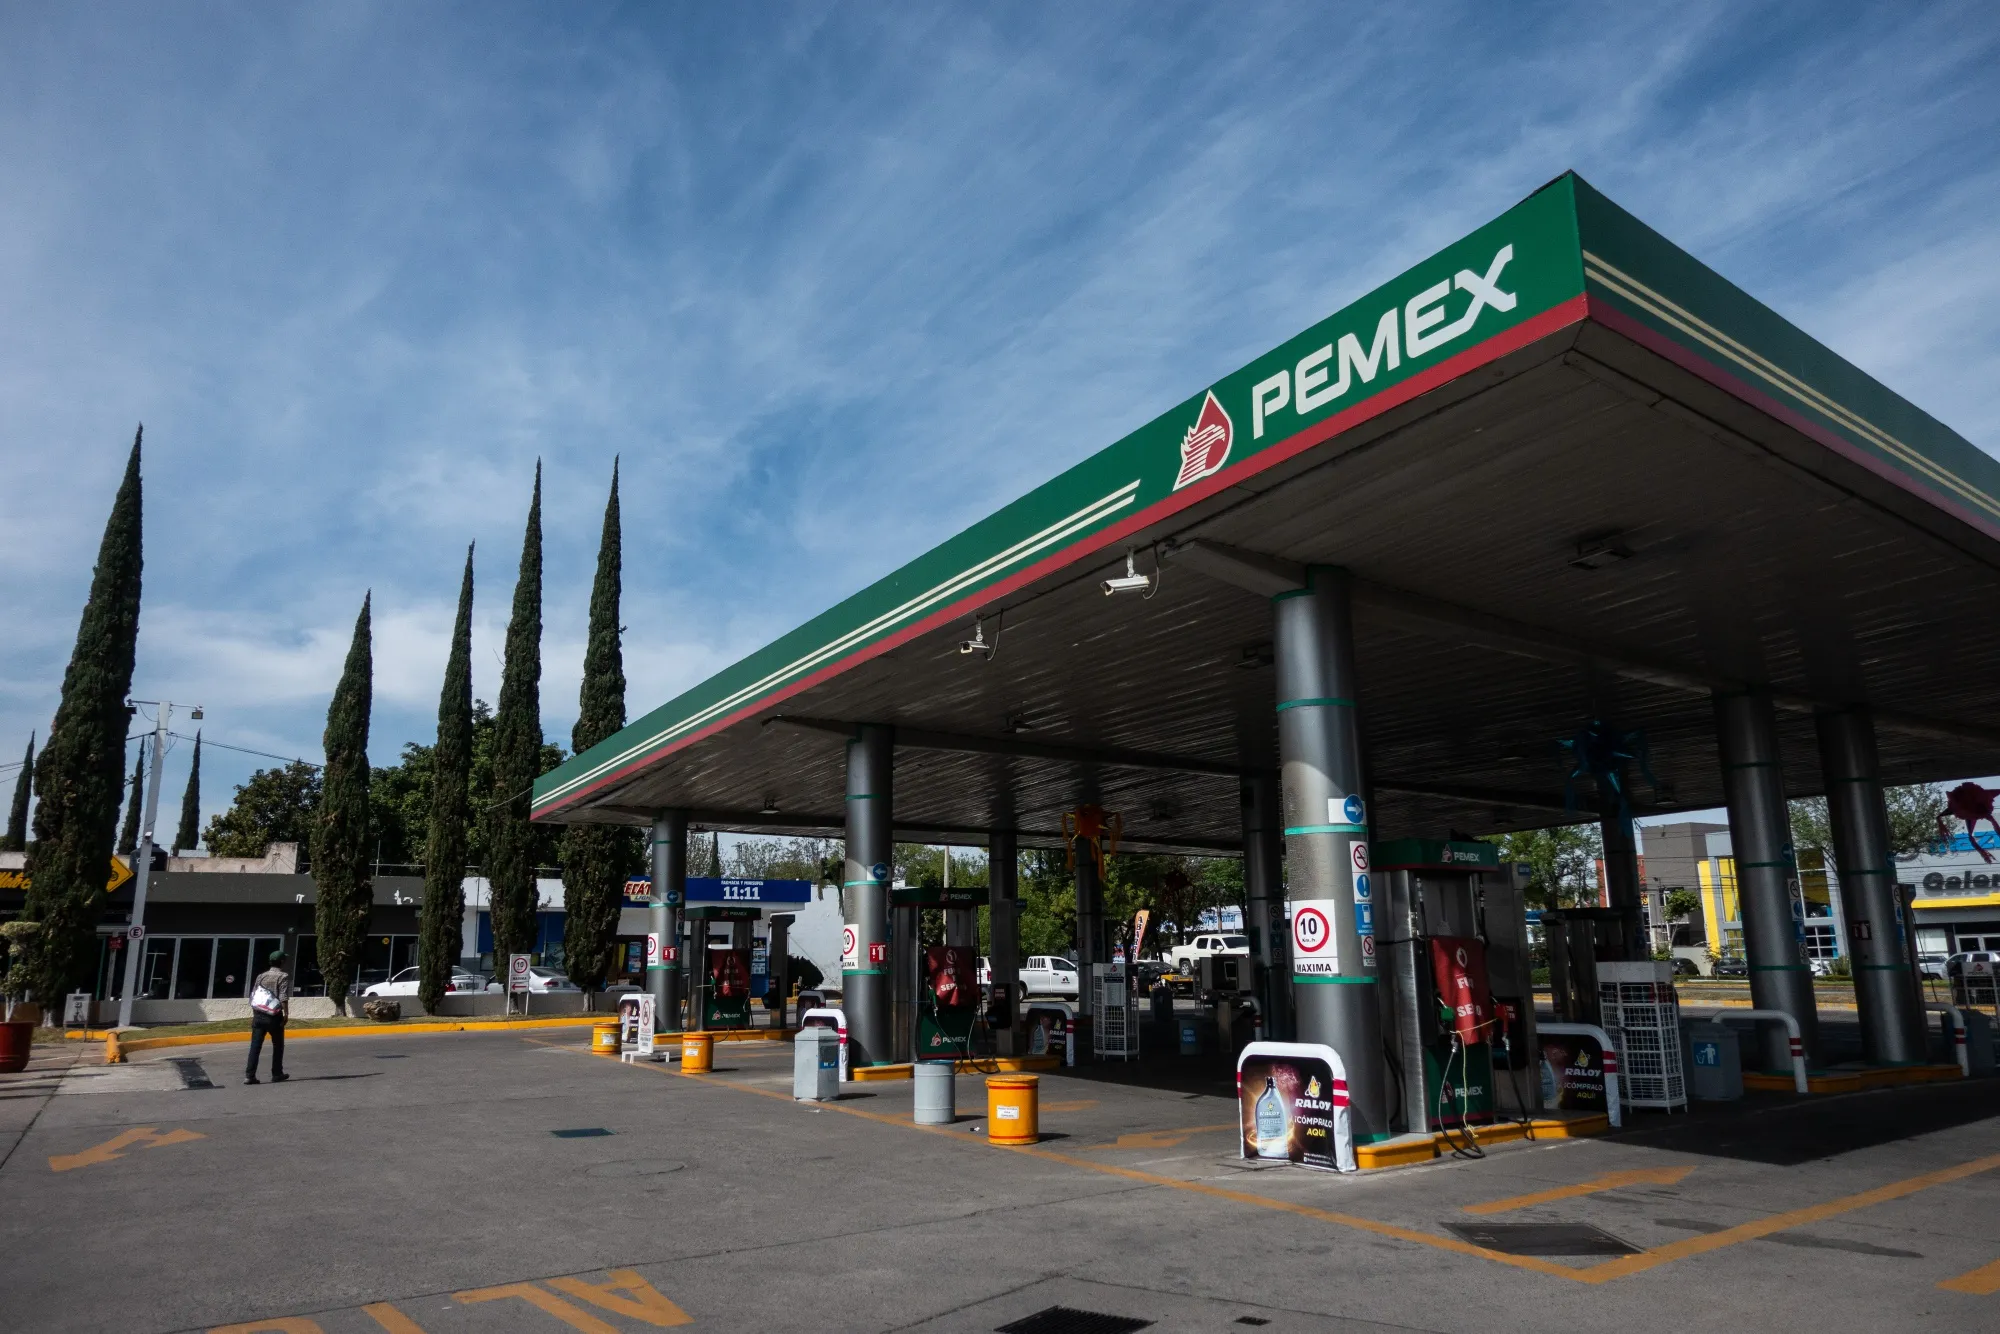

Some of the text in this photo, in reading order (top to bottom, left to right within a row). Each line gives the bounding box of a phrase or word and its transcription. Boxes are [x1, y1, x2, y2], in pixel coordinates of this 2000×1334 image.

[1252, 243, 1517, 439] PEMEX
[1454, 852, 1479, 862] PEMEX
[723, 886, 760, 900] 11:11
[133, 928, 140, 936] E
[1300, 917, 1317, 935] 10
[1296, 963, 1331, 972] MAXIMA
[1565, 1068, 1602, 1077] RALOY
[1454, 1085, 1483, 1097] PEMEX
[1295, 1098, 1331, 1111] RALOY
